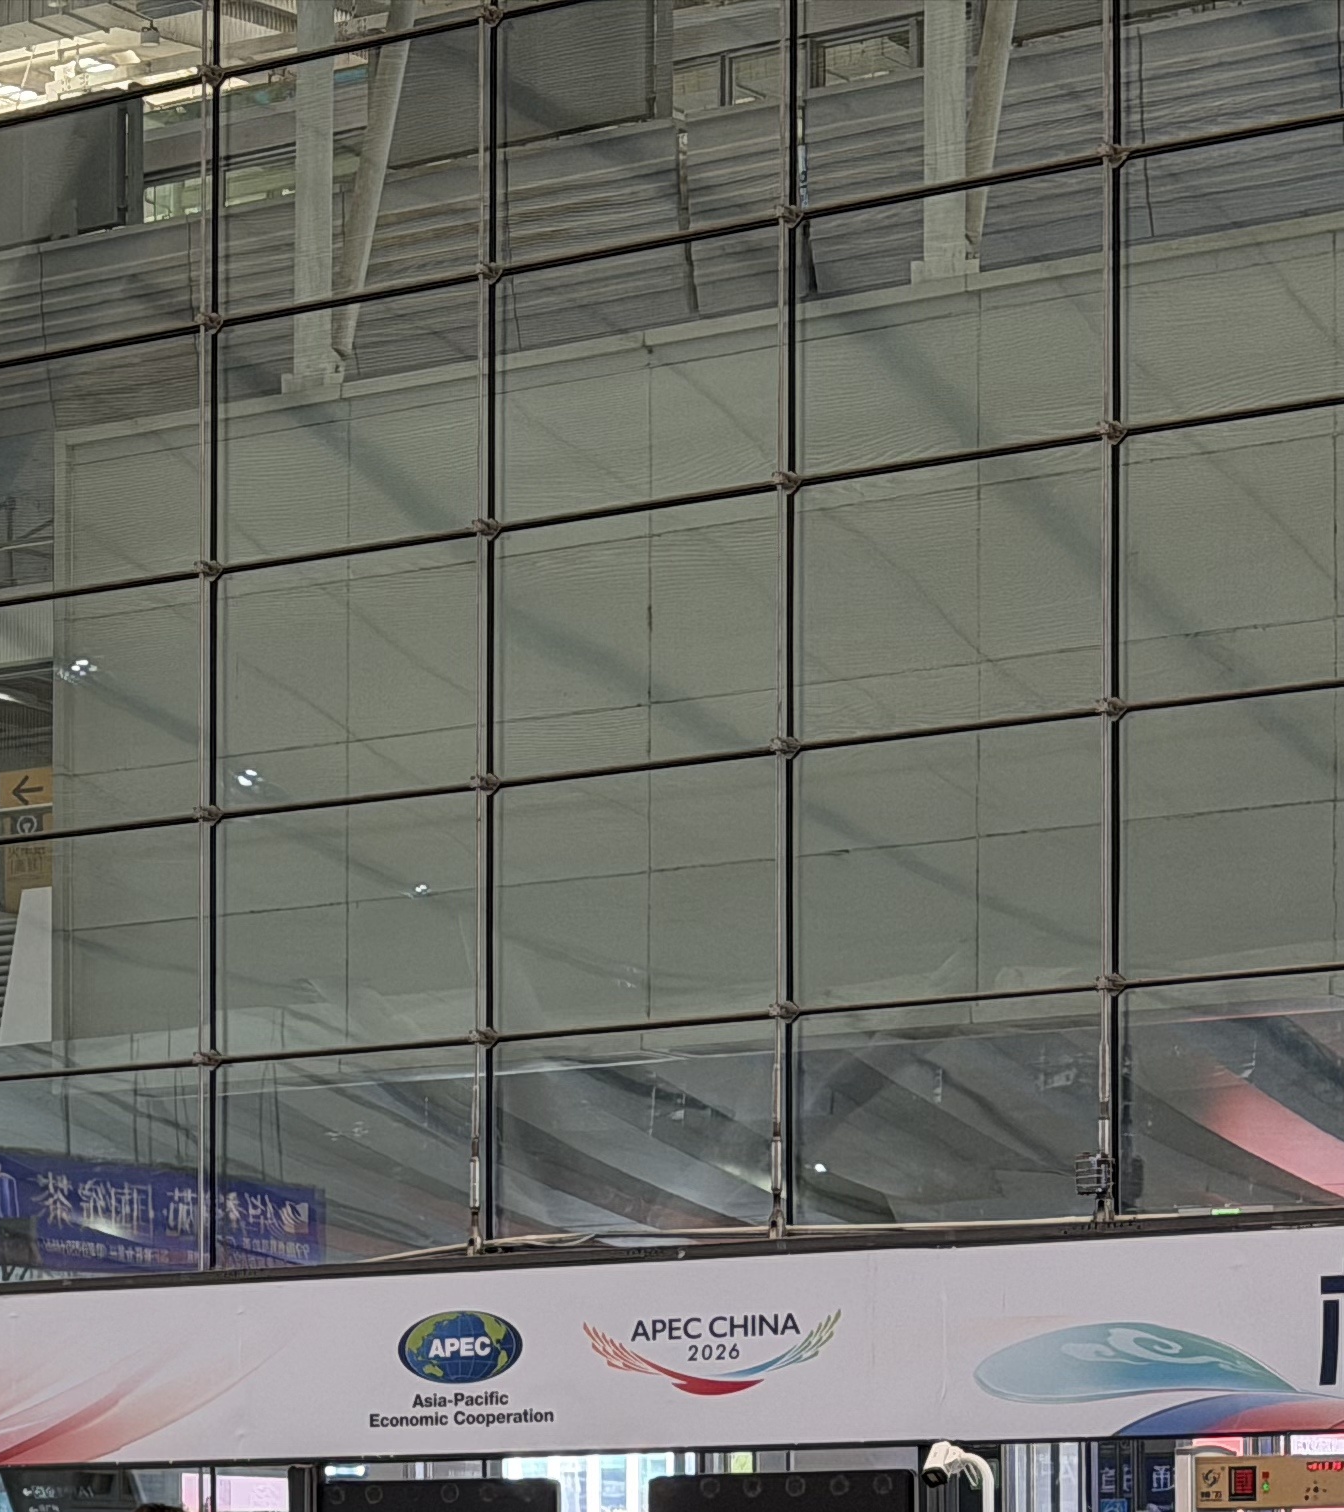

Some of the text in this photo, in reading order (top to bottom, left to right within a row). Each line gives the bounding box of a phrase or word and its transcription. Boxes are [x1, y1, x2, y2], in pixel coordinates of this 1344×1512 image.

[630, 1312, 802, 1342] APEC CHINA
[428, 1335, 492, 1358] APEC
[687, 1343, 740, 1363] 2026
[412, 1391, 509, 1408] Asia-Pacific
[369, 1408, 555, 1428] Economic Cooperation
